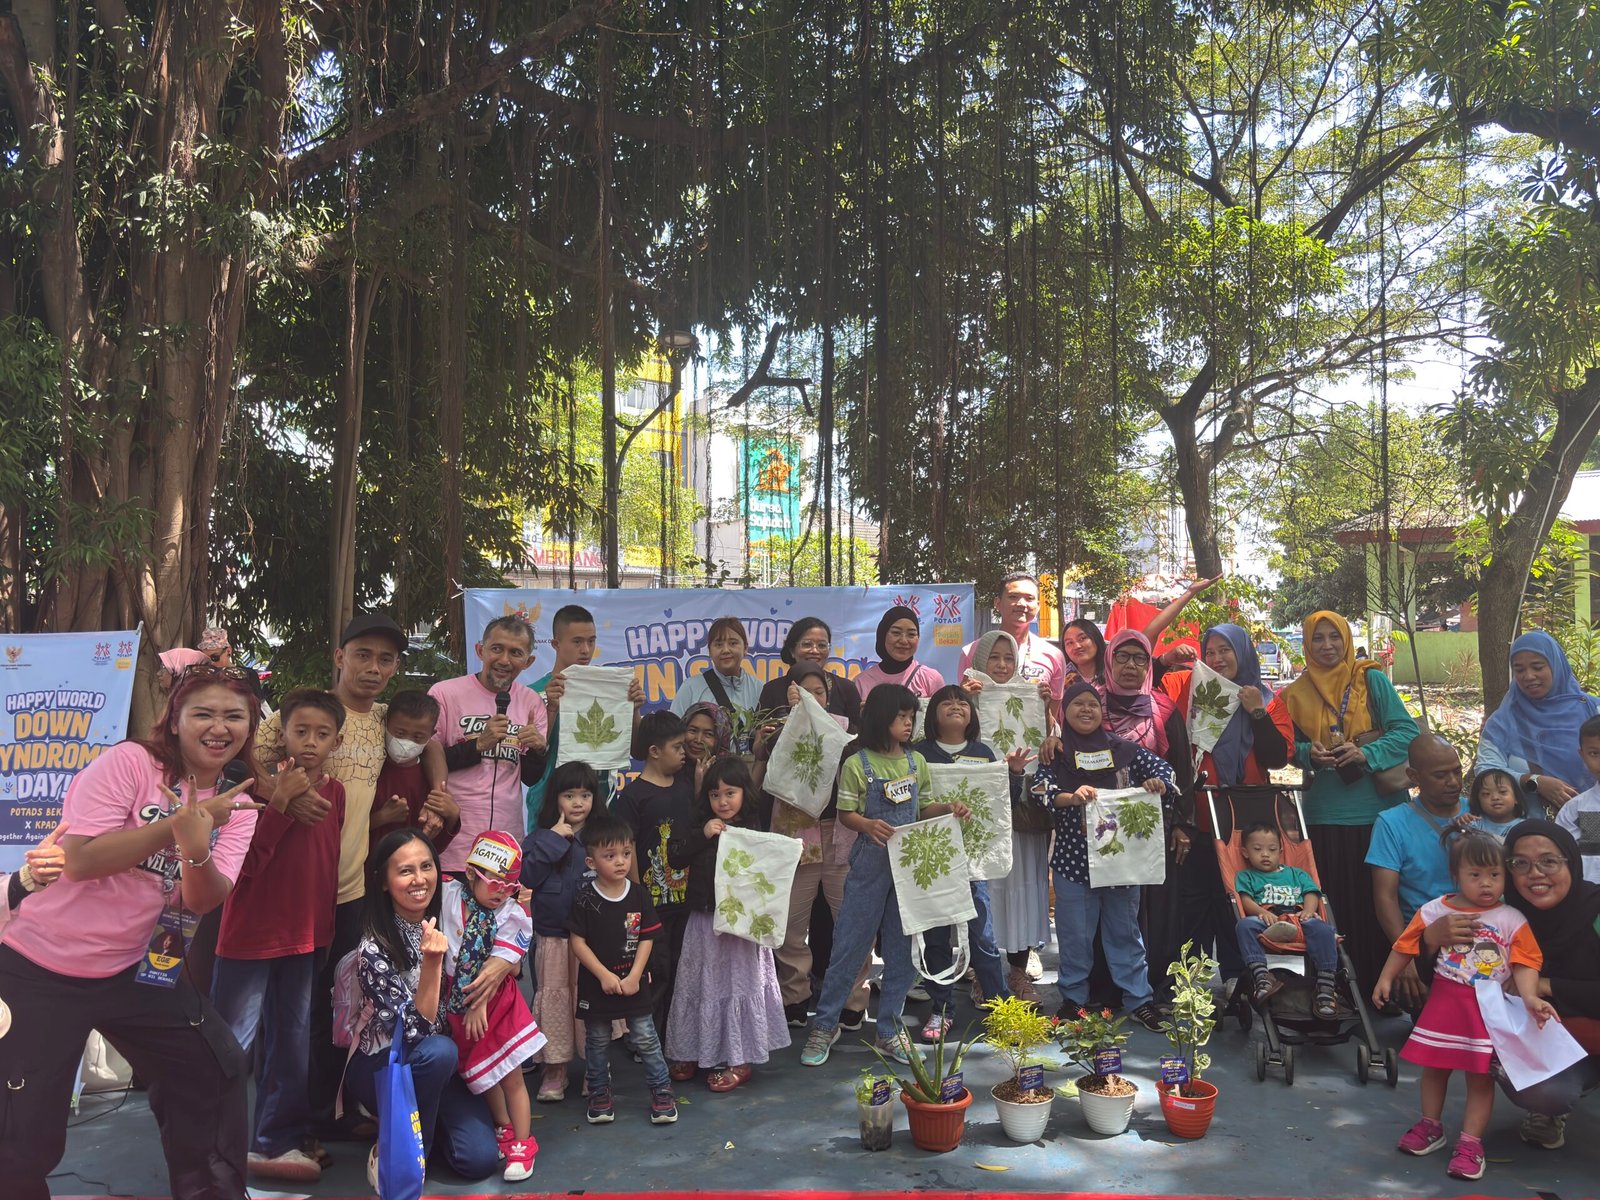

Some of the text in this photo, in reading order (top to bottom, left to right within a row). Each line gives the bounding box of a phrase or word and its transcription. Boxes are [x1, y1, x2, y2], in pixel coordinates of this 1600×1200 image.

[6, 690, 105, 713] HAPPY WORLD
[15, 710, 92, 740] DOWN
[17, 772, 73, 800] DAY!
[10, 807, 43, 816] POTADS
[35, 821, 57, 829] KPAD
[0, 832, 23, 841] ogether
[474, 847, 508, 866] AGATHA
